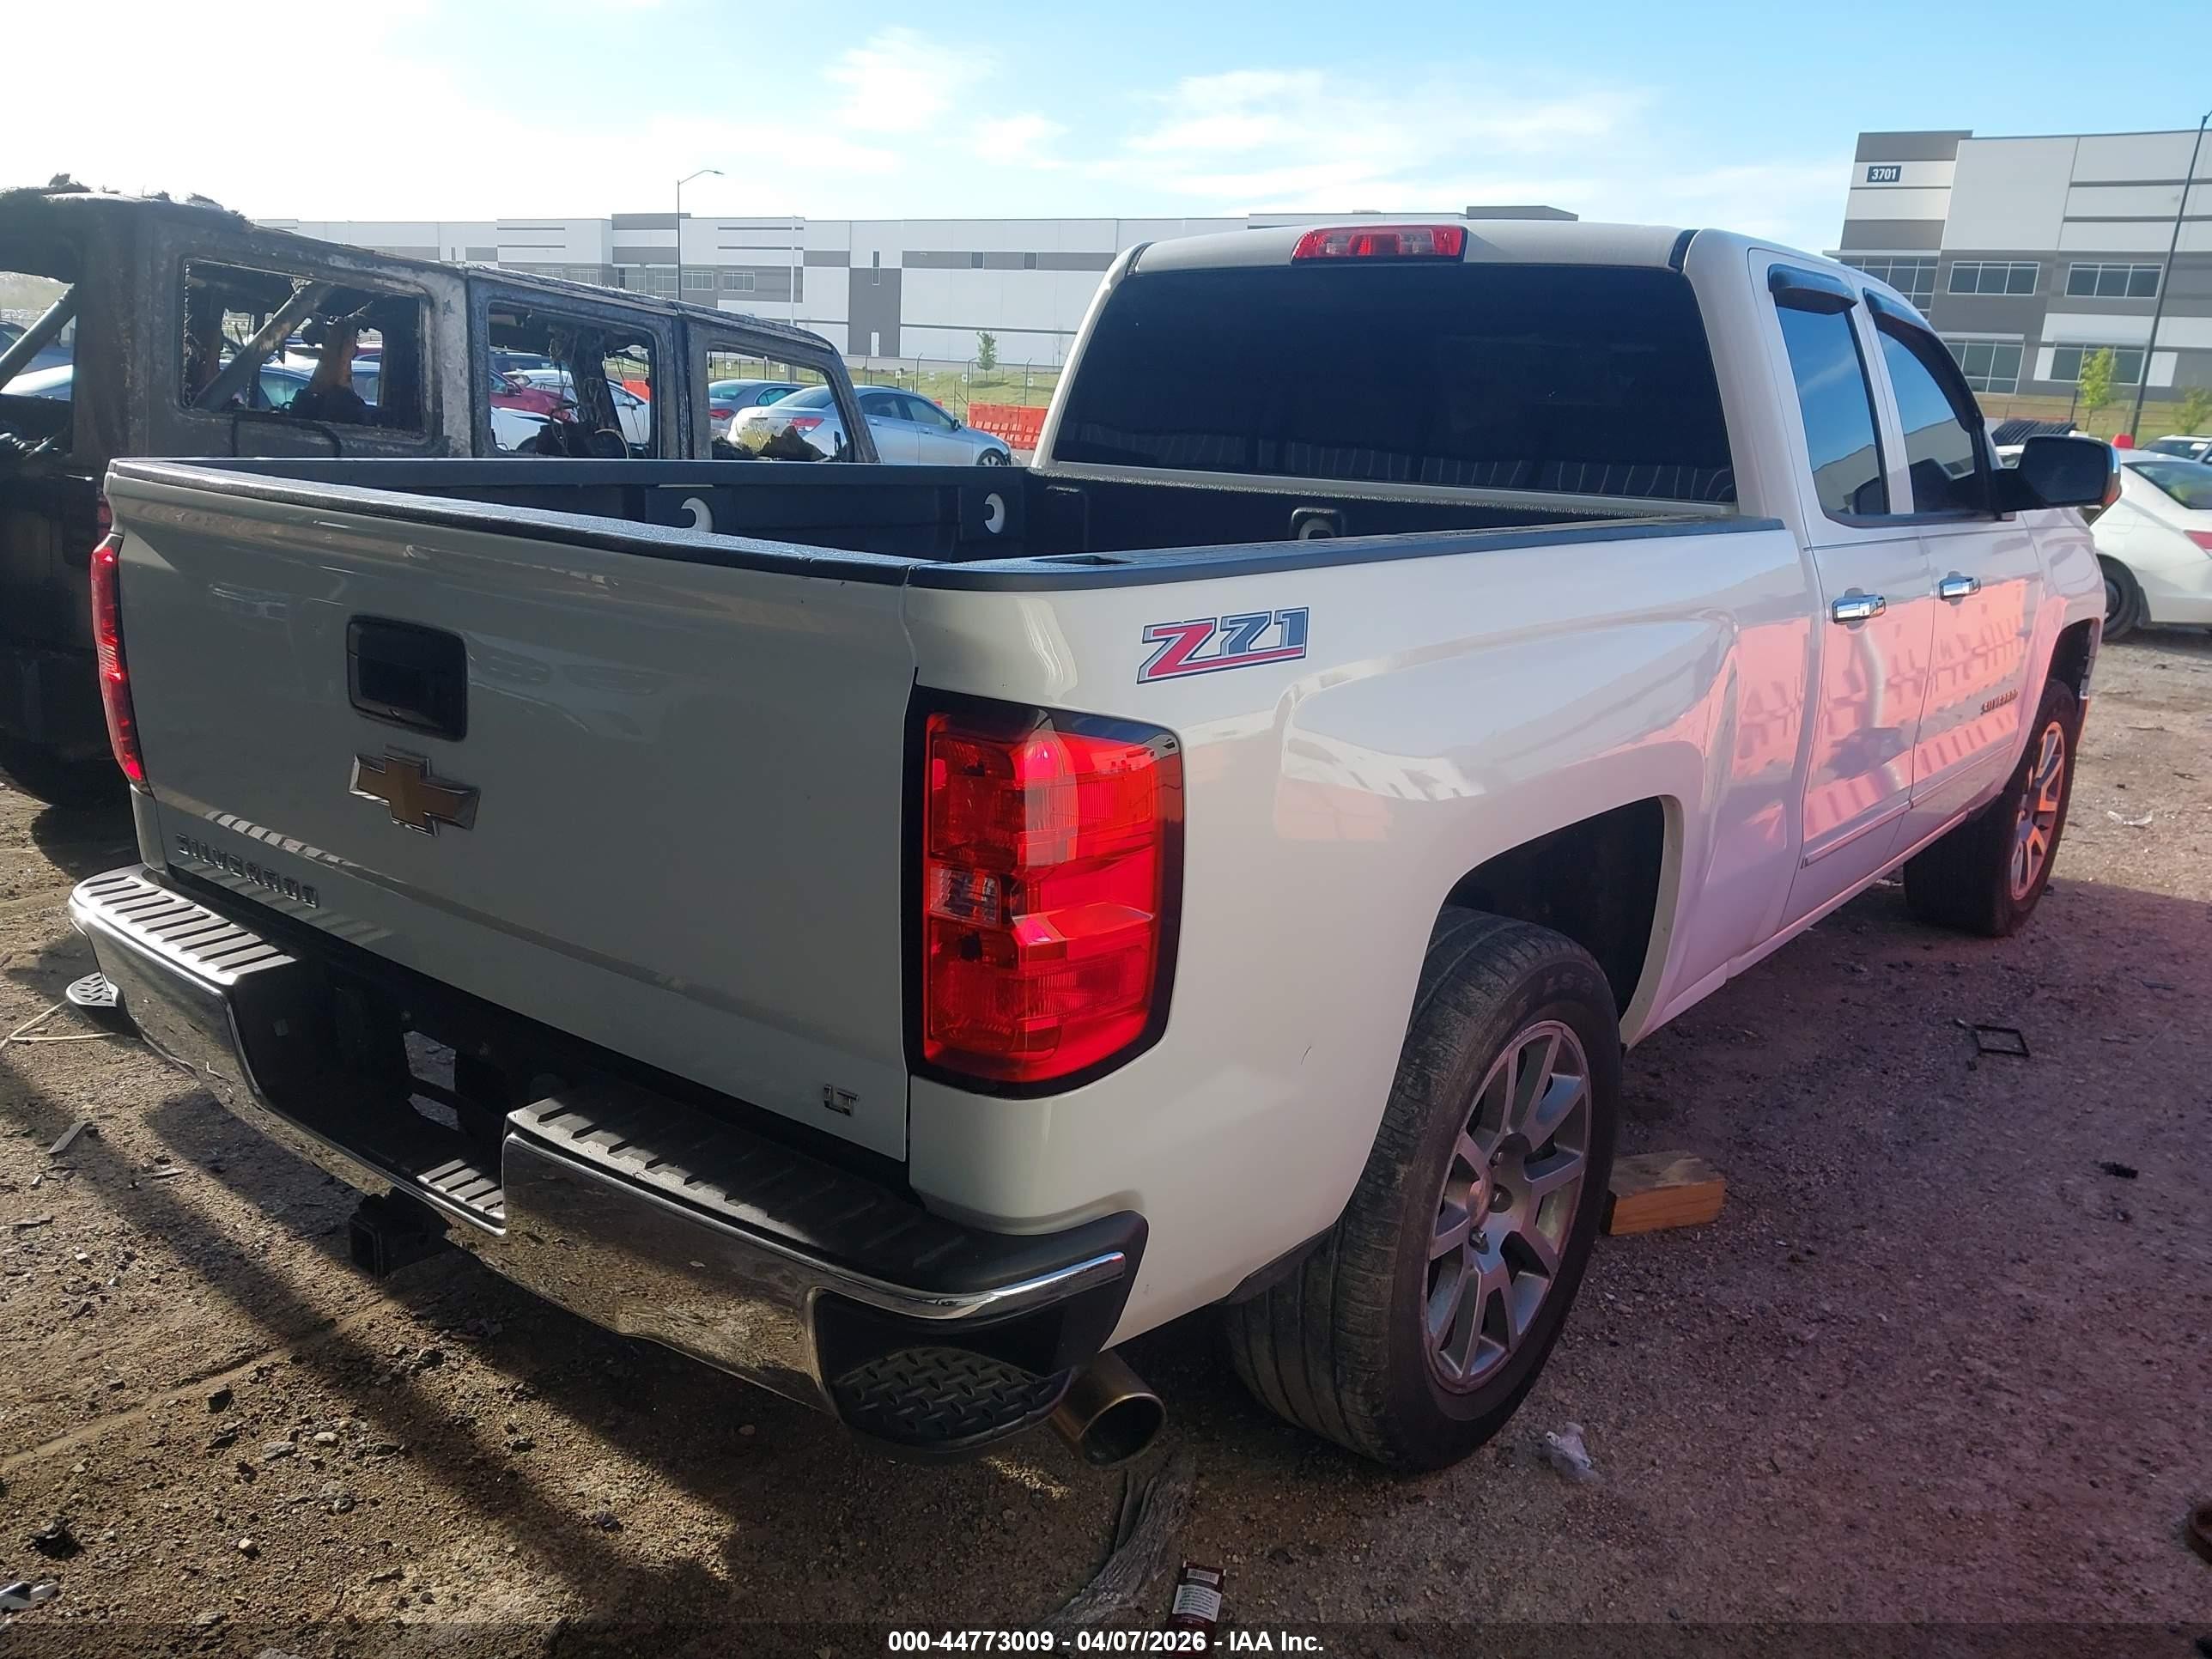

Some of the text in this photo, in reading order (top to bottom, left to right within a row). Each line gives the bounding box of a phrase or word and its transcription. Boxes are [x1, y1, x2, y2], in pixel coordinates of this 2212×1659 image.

[1872, 168, 1897, 179] 3701
[1137, 607, 1309, 684] Z71
[176, 833, 319, 908] SILVERADO
[823, 1084, 860, 1117] LT
